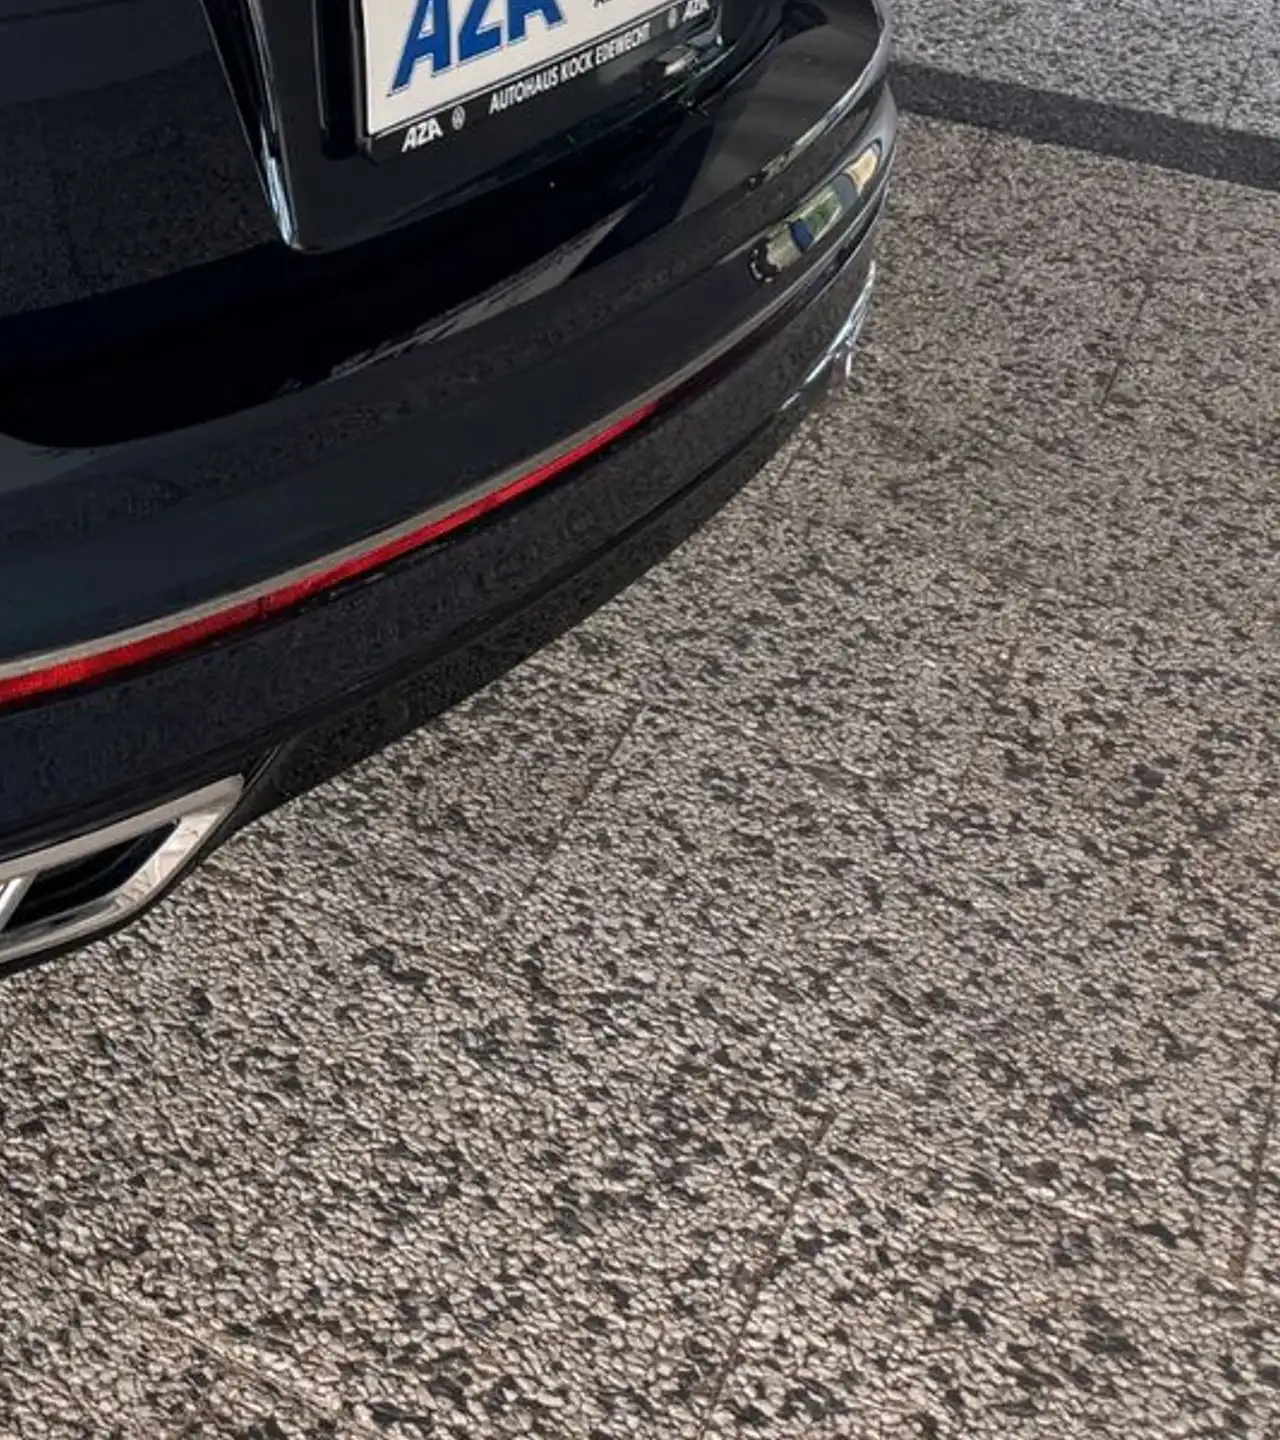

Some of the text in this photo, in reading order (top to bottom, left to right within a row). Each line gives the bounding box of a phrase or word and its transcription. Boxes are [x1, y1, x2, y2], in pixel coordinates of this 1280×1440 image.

[401, 117, 443, 153] AZA
[488, 65, 559, 116] AUTOHAUS
[560, 48, 593, 84] KOCK
